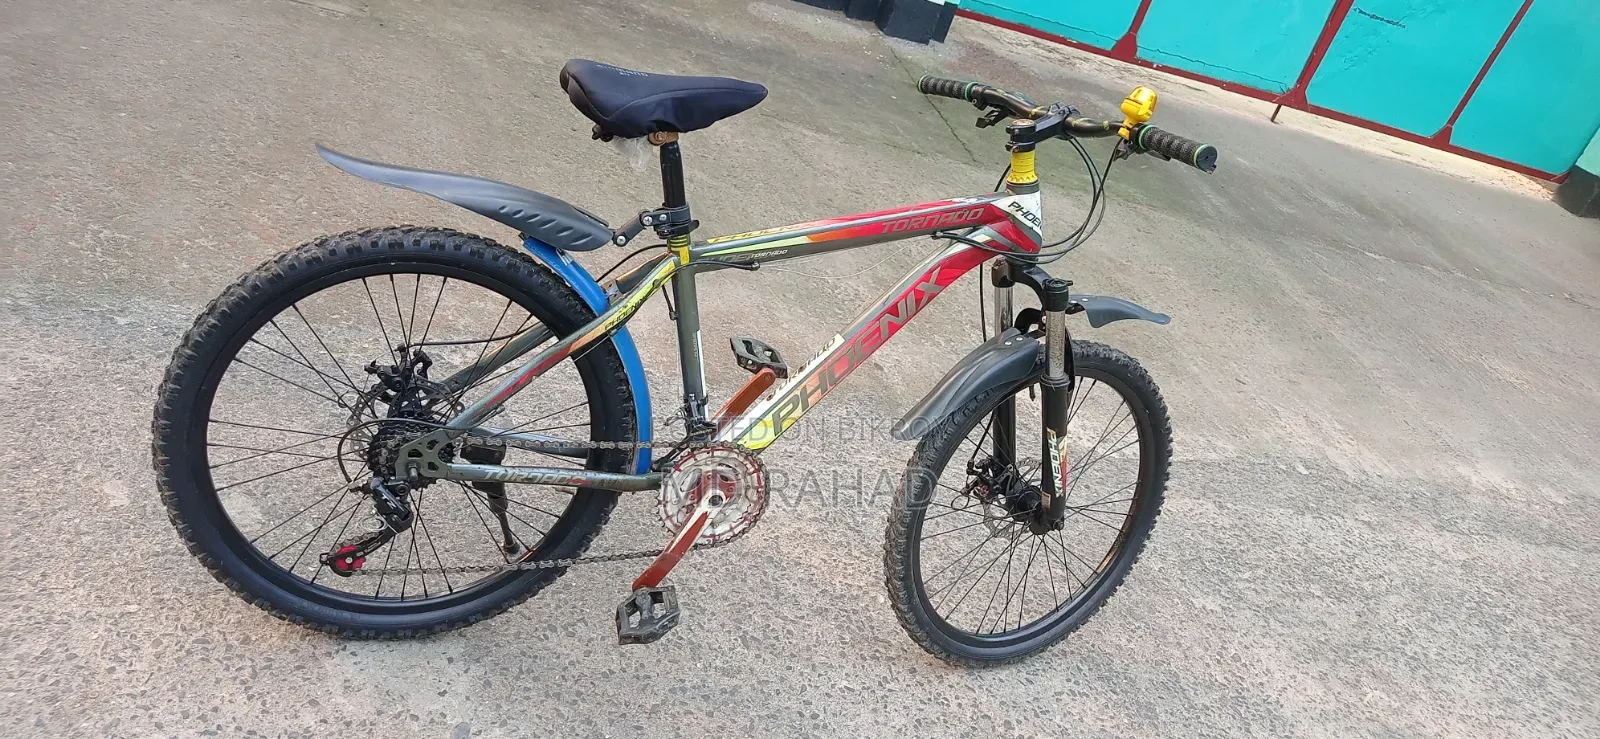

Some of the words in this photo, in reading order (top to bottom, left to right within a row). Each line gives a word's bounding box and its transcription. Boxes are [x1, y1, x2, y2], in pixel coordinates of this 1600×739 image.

[882, 207, 985, 235] TORNADO
[1007, 201, 1042, 229] PHOE
[771, 266, 945, 437] PHOENIX
